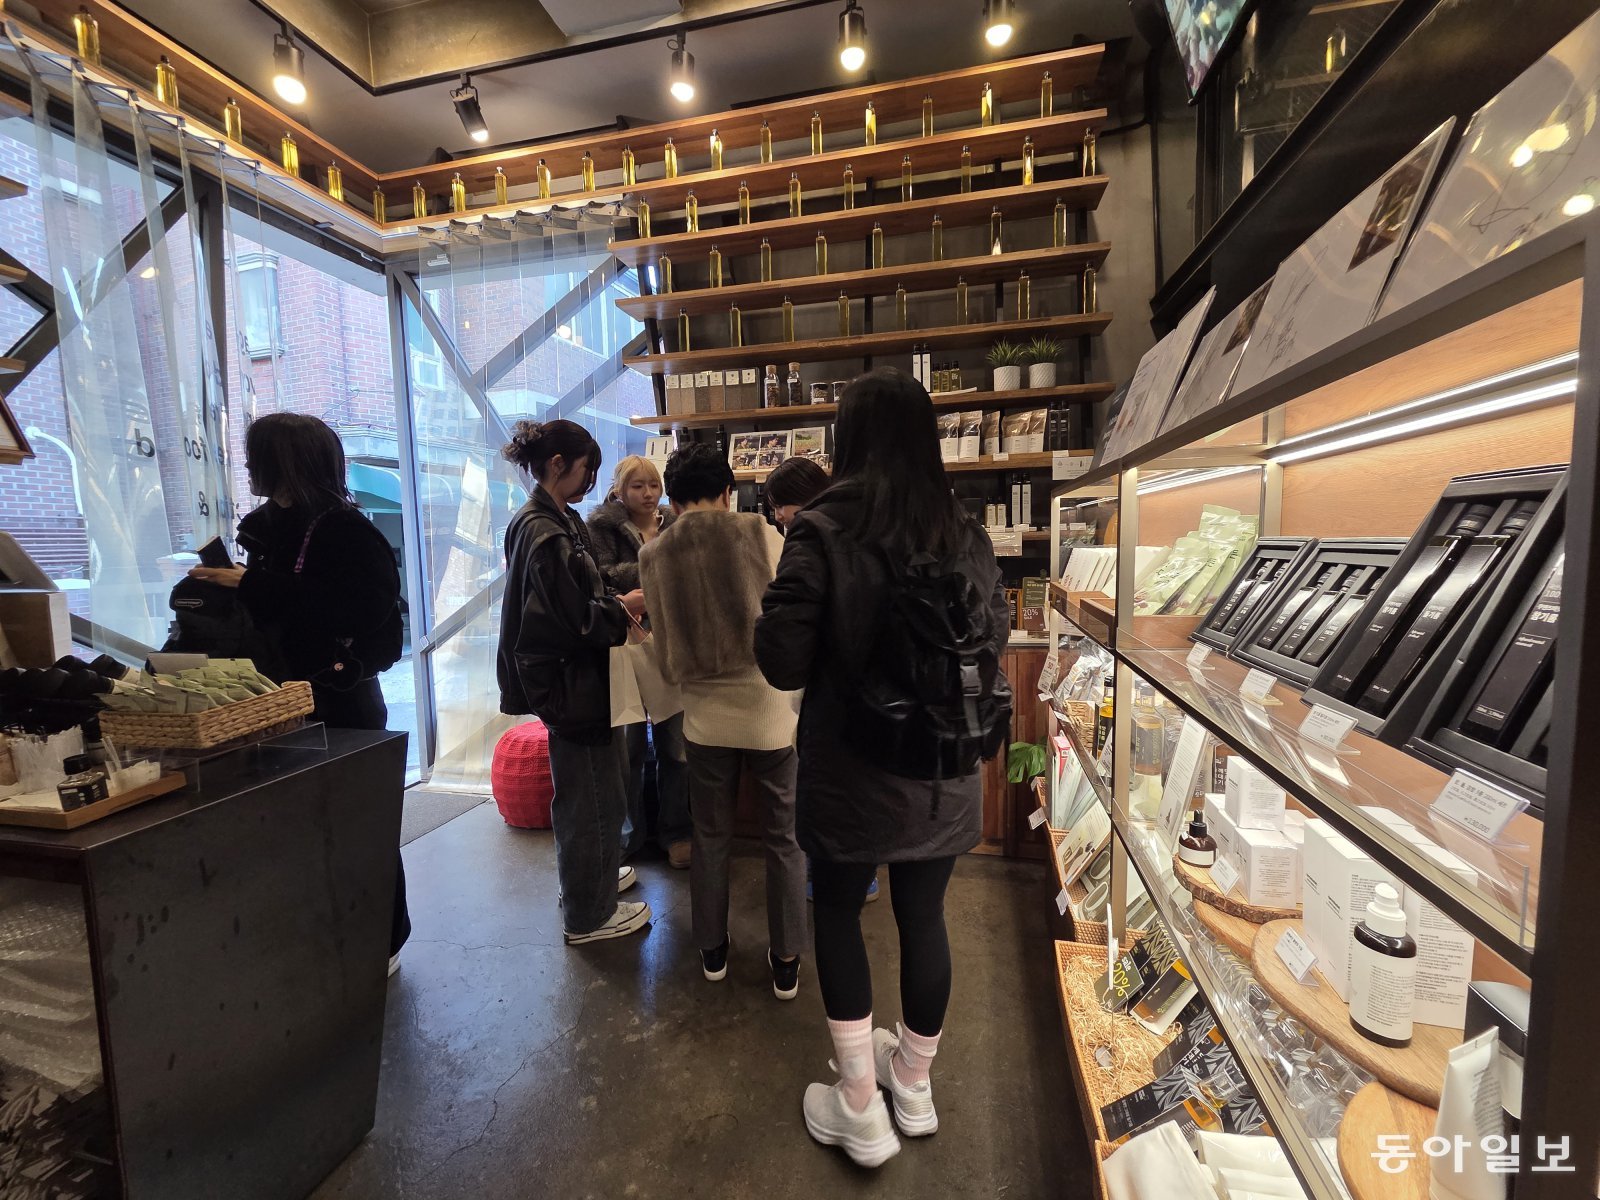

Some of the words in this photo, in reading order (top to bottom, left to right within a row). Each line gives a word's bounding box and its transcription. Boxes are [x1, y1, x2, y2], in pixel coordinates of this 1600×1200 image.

[1023, 608, 1039, 616] 20%
[1121, 956, 1132, 972] sale
[1113, 962, 1131, 997] 20%
